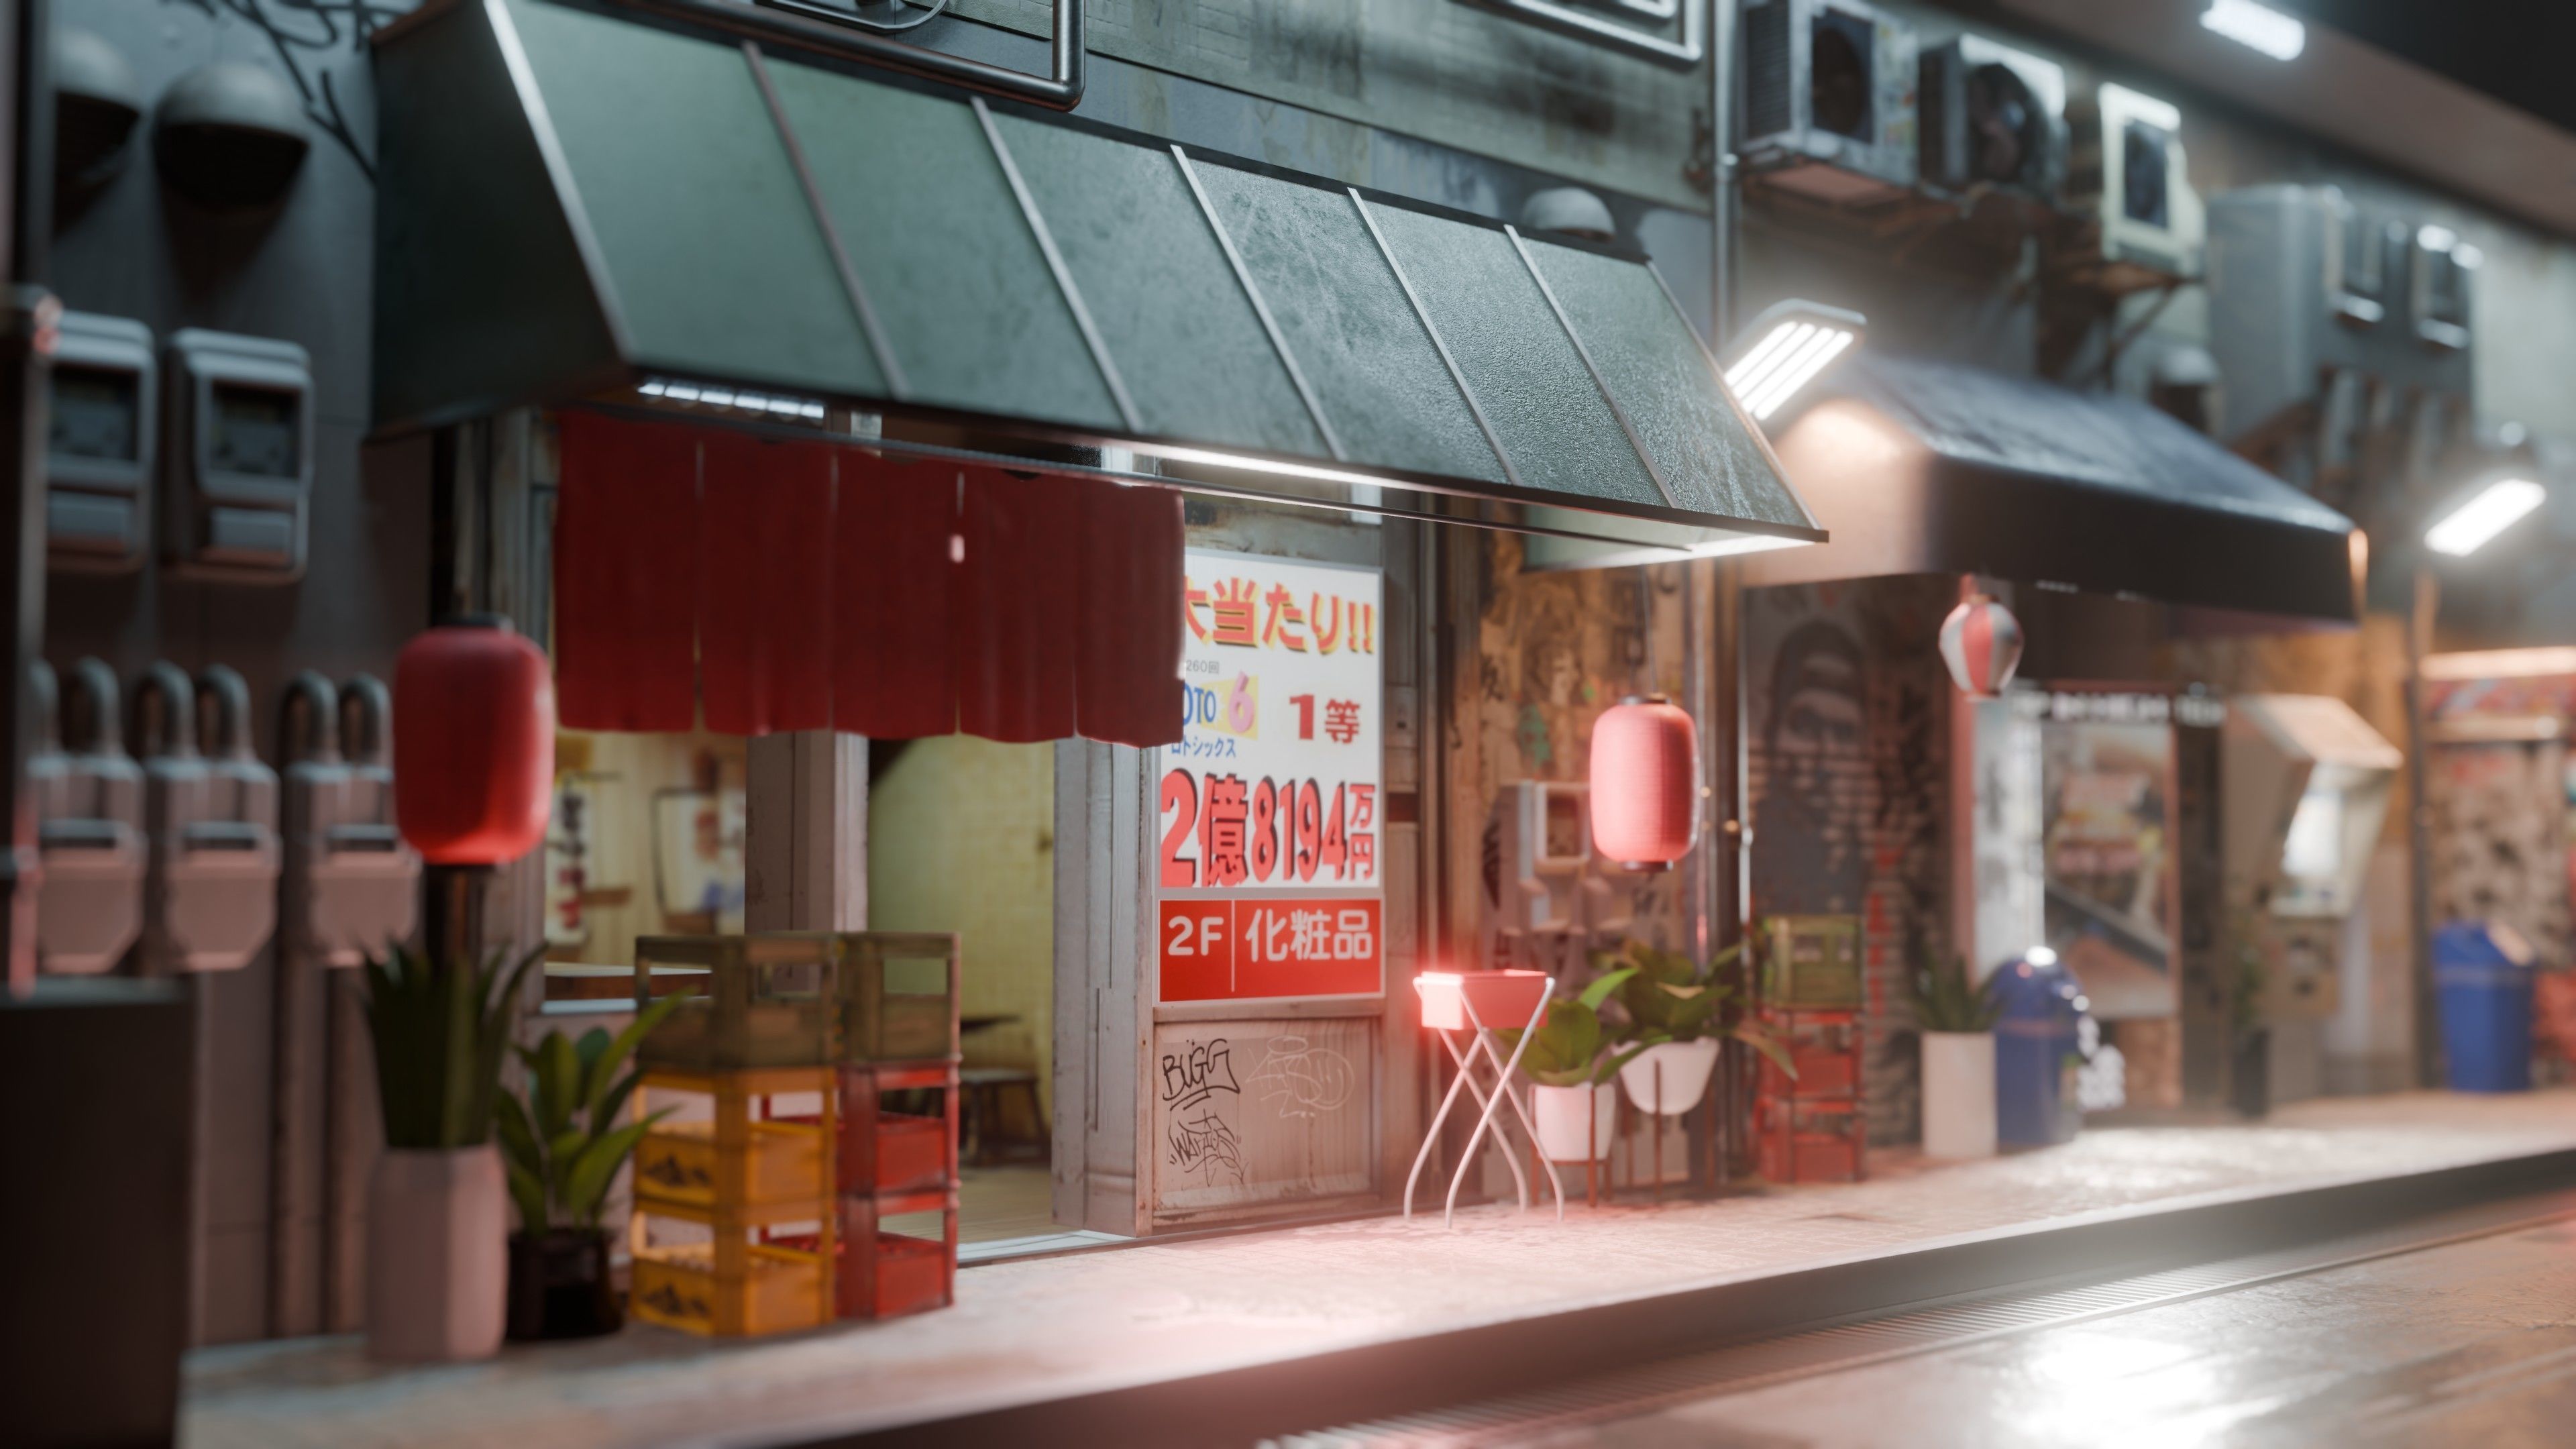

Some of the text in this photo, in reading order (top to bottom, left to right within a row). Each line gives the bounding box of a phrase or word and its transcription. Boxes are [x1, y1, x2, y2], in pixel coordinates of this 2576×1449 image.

[1228, 670, 1255, 733] 6
[1289, 694, 1360, 744] 1等
[1168, 916, 1224, 956] 2F
[1245, 908, 1373, 962] 化粧品
